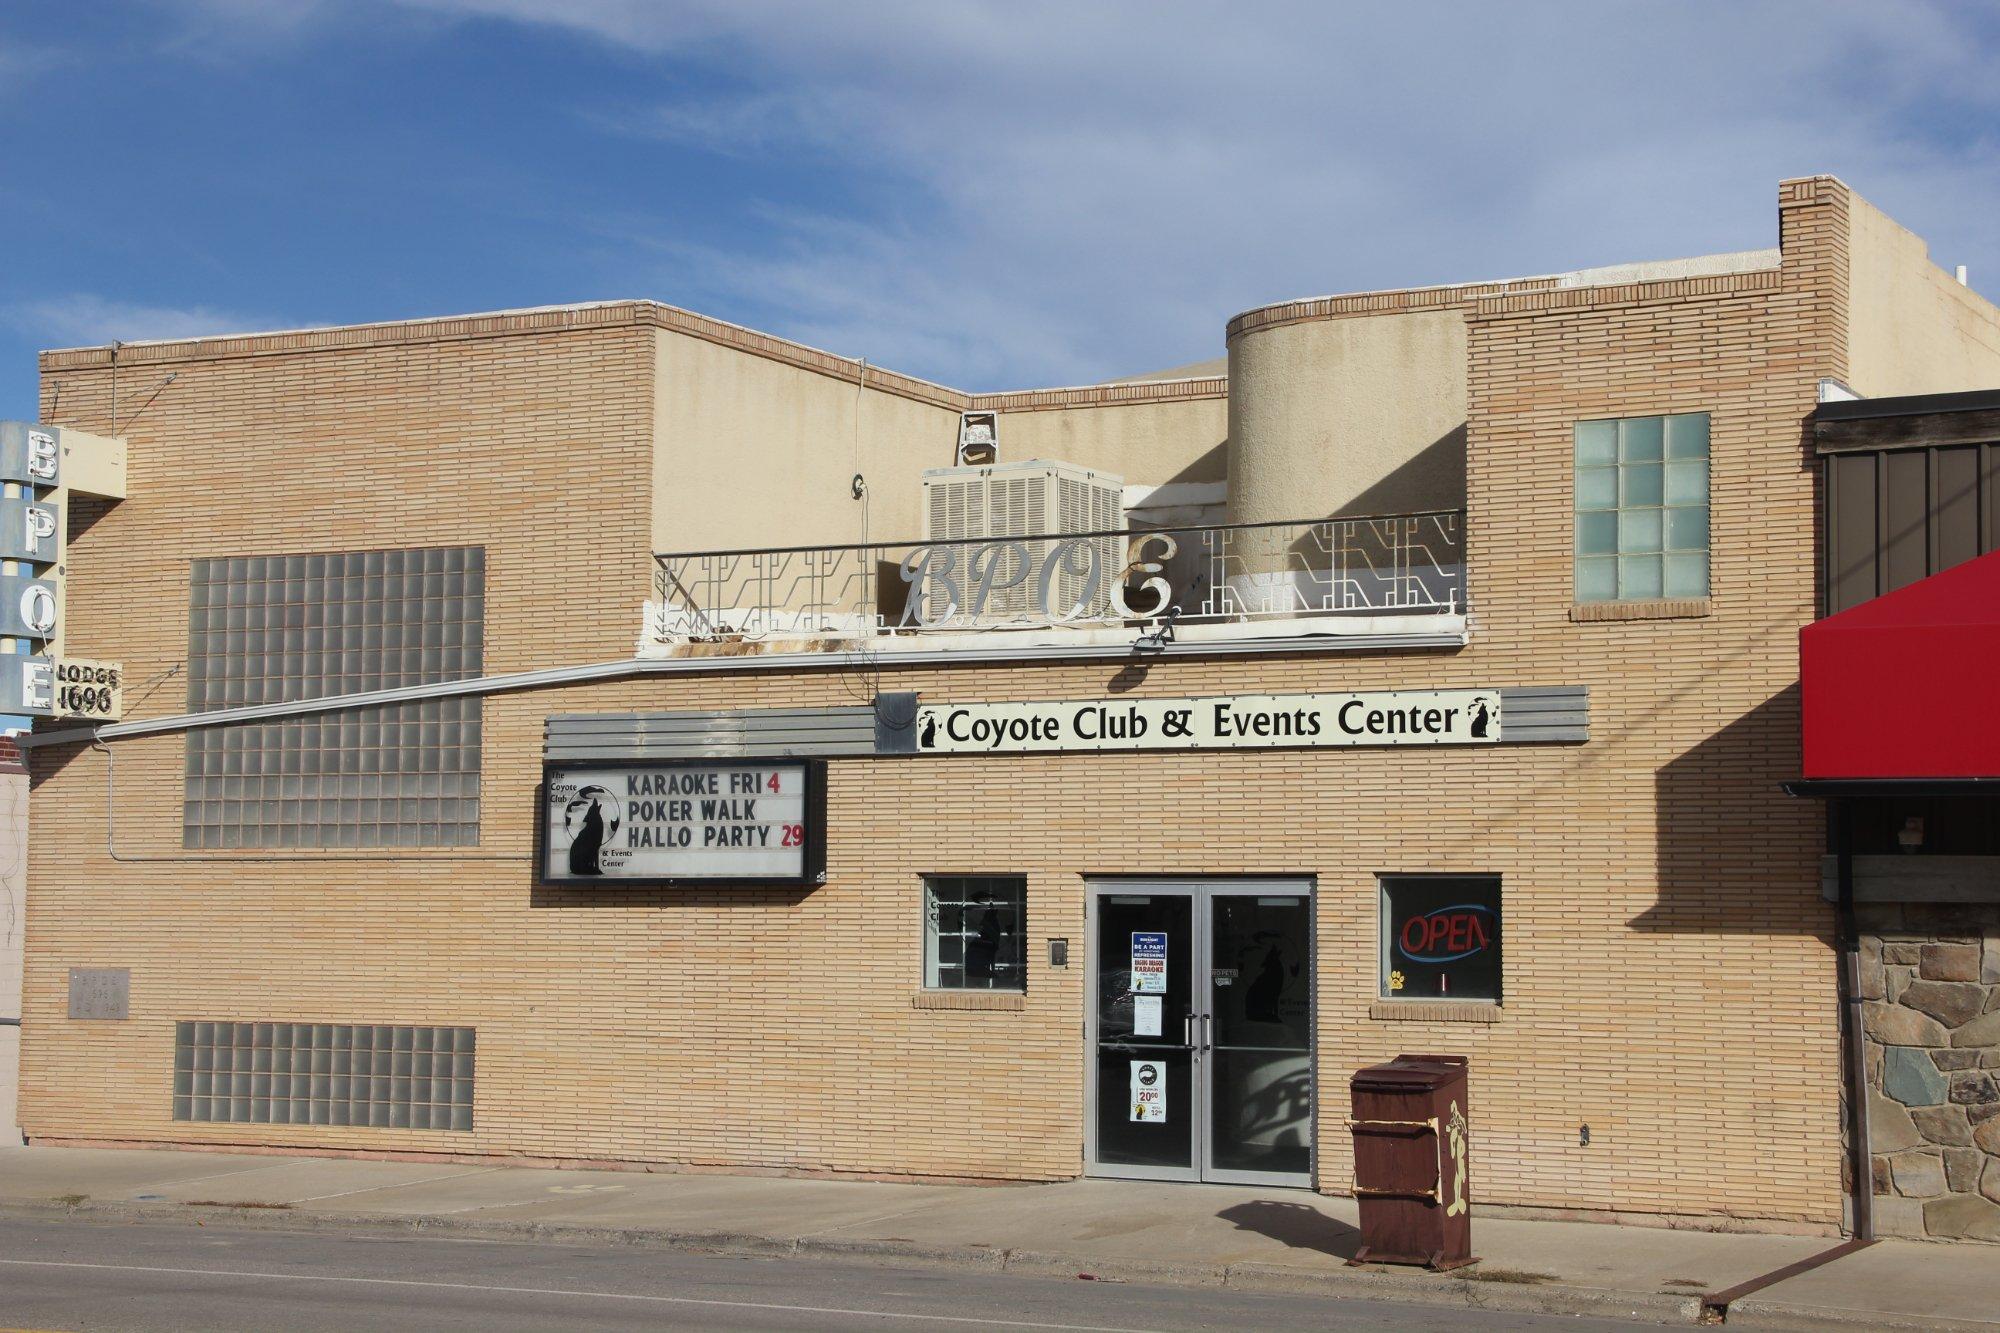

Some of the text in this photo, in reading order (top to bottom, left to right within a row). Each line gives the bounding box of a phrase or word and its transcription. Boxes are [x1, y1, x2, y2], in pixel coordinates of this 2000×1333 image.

[58, 664, 117, 686] LODGE
[60, 686, 111, 713] 1696
[947, 700, 1459, 748] Coyote Club & Events Center
[552, 771, 565, 779] The
[627, 772, 781, 796] KARAOKE FRI 4
[551, 782, 578, 791] Coyote
[551, 794, 568, 803] Club
[628, 799, 756, 822] POKER WALK
[628, 824, 804, 848] HALLO PARTY 29
[602, 859, 625, 867] Center
[611, 849, 633, 857] Events
[1402, 914, 1491, 954] OPEN
